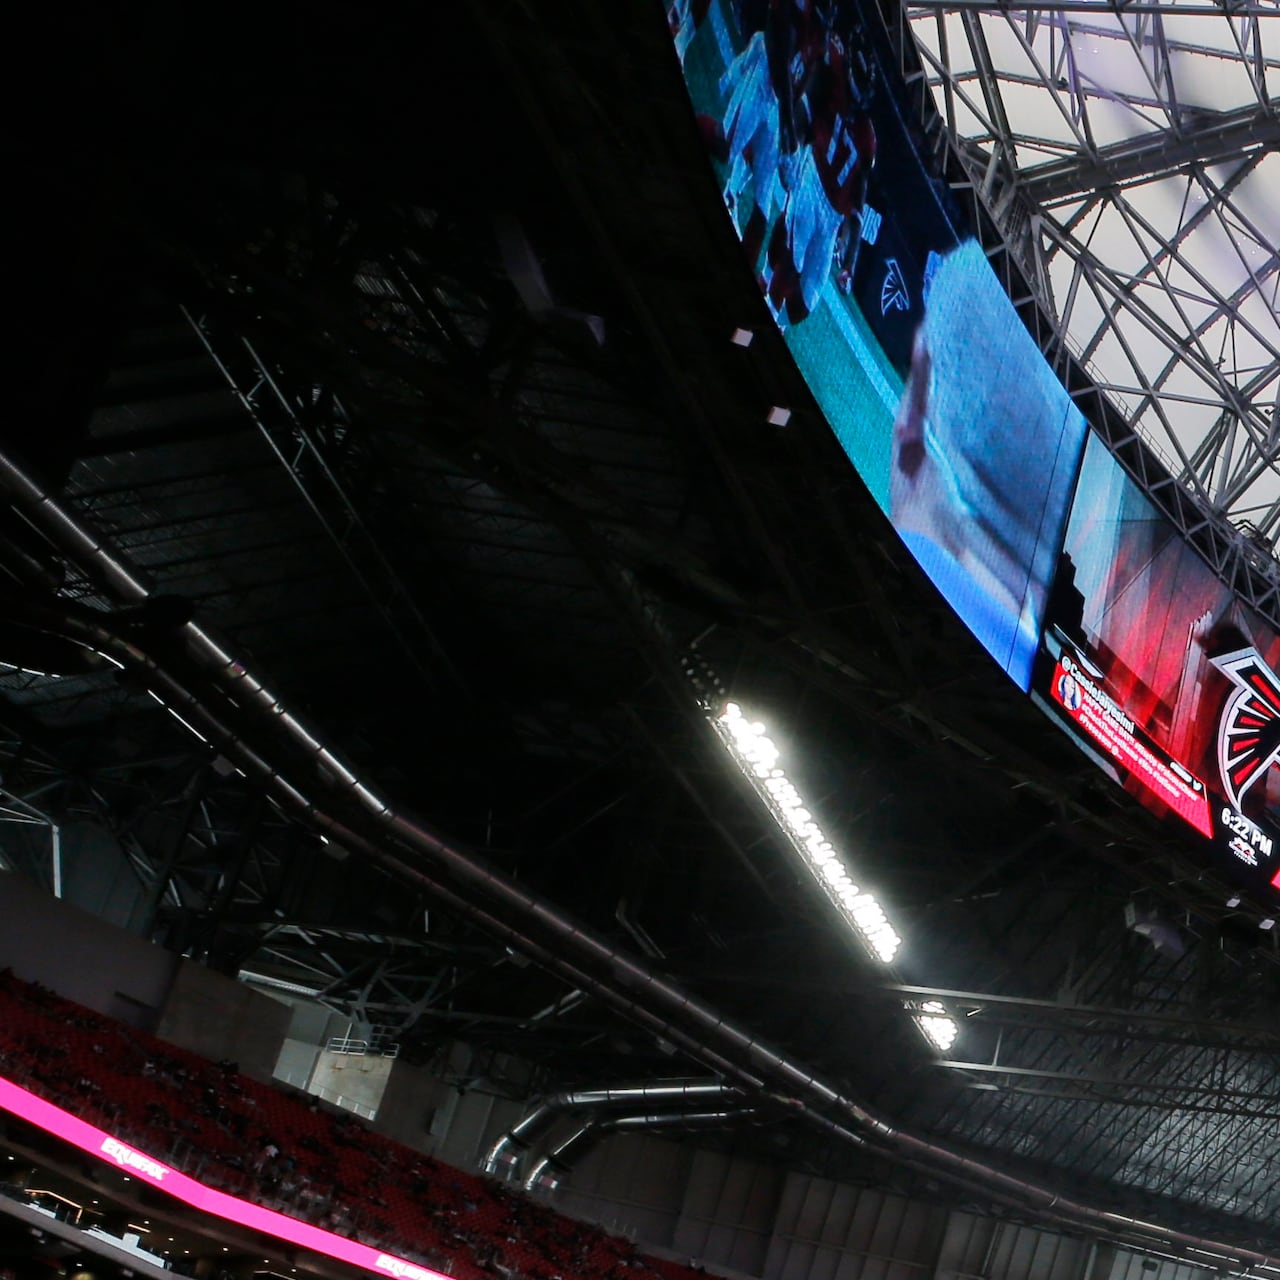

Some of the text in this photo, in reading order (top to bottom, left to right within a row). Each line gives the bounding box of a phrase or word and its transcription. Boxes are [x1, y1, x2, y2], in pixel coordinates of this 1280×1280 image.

[1220, 807, 1249, 840] 6:22
[1250, 828, 1273, 857] PM
[101, 1138, 169, 1182] EQUIFAX
